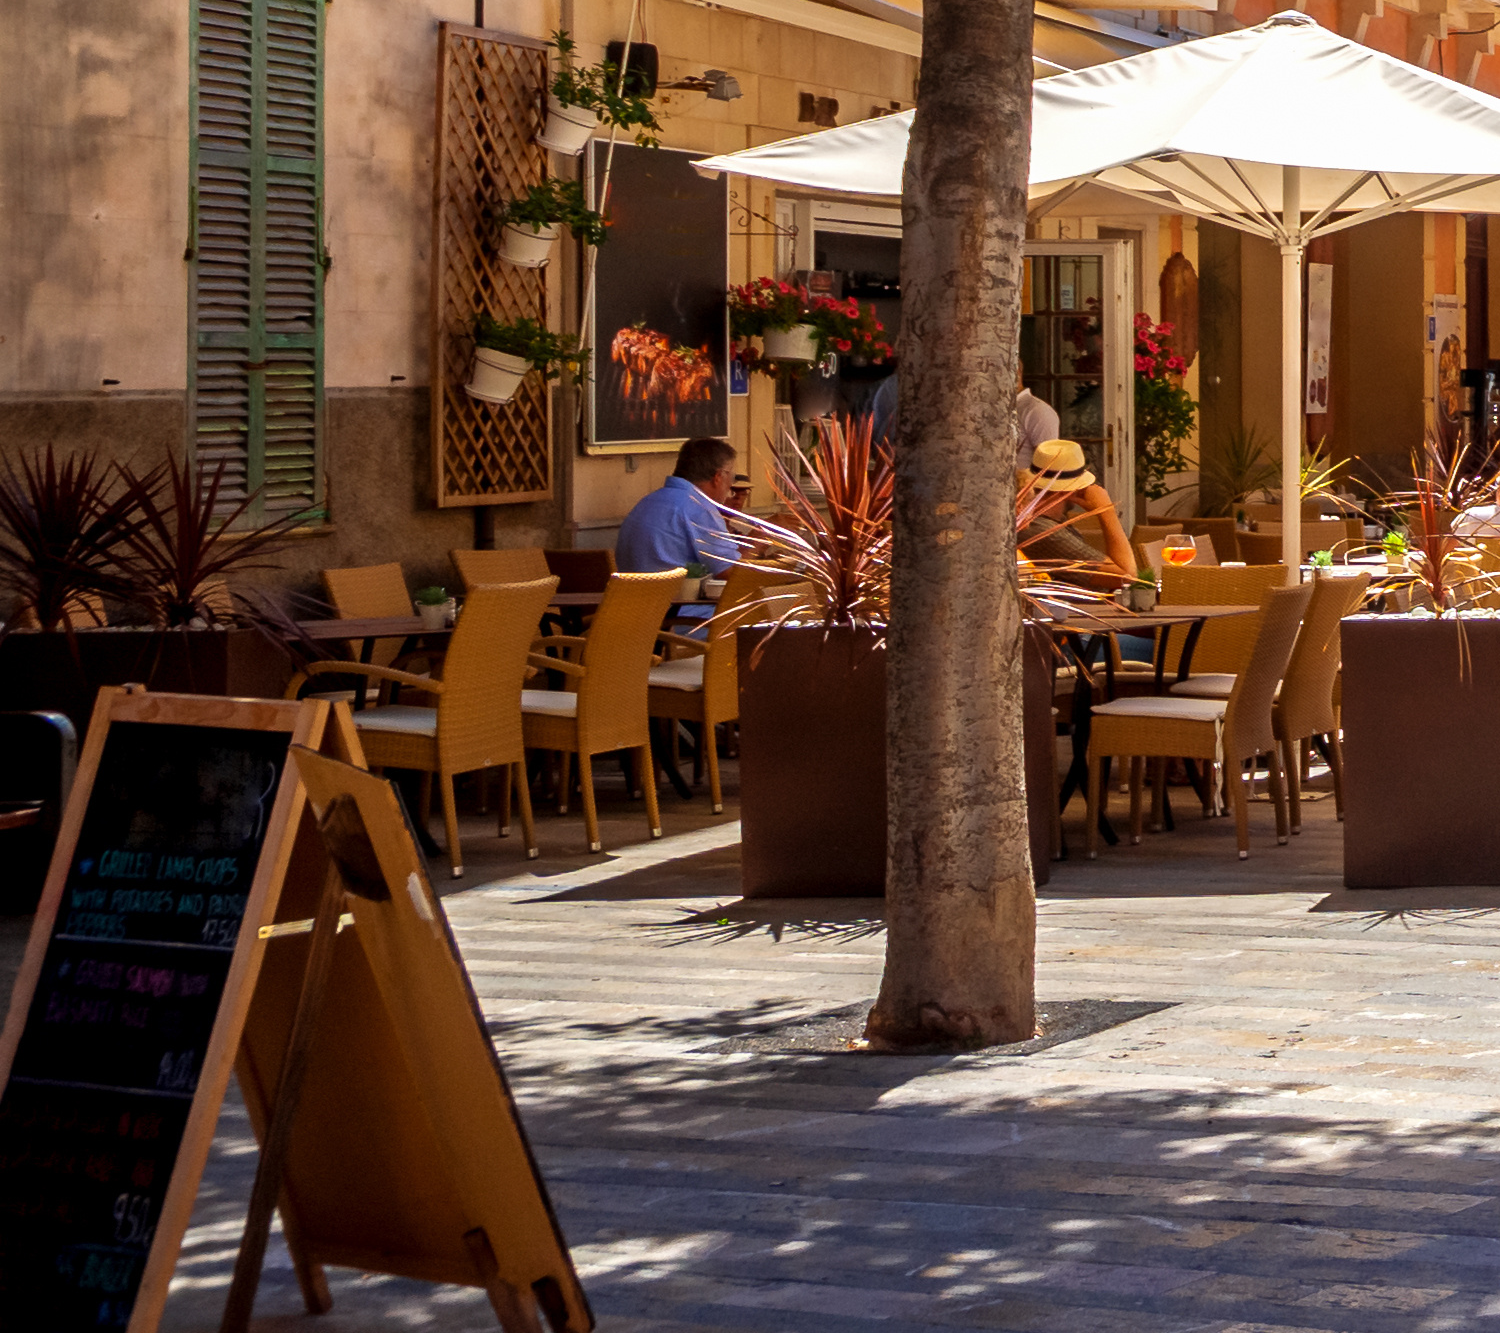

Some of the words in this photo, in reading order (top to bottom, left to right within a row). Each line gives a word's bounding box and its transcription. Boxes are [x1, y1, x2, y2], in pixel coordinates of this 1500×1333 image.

[155, 854, 195, 881] LAMB
[194, 856, 239, 886] CHOPS
[71, 888, 108, 910] WITH
[109, 888, 174, 914] POTATOES
[176, 893, 204, 916] AND
[65, 911, 127, 939] PEPPERS
